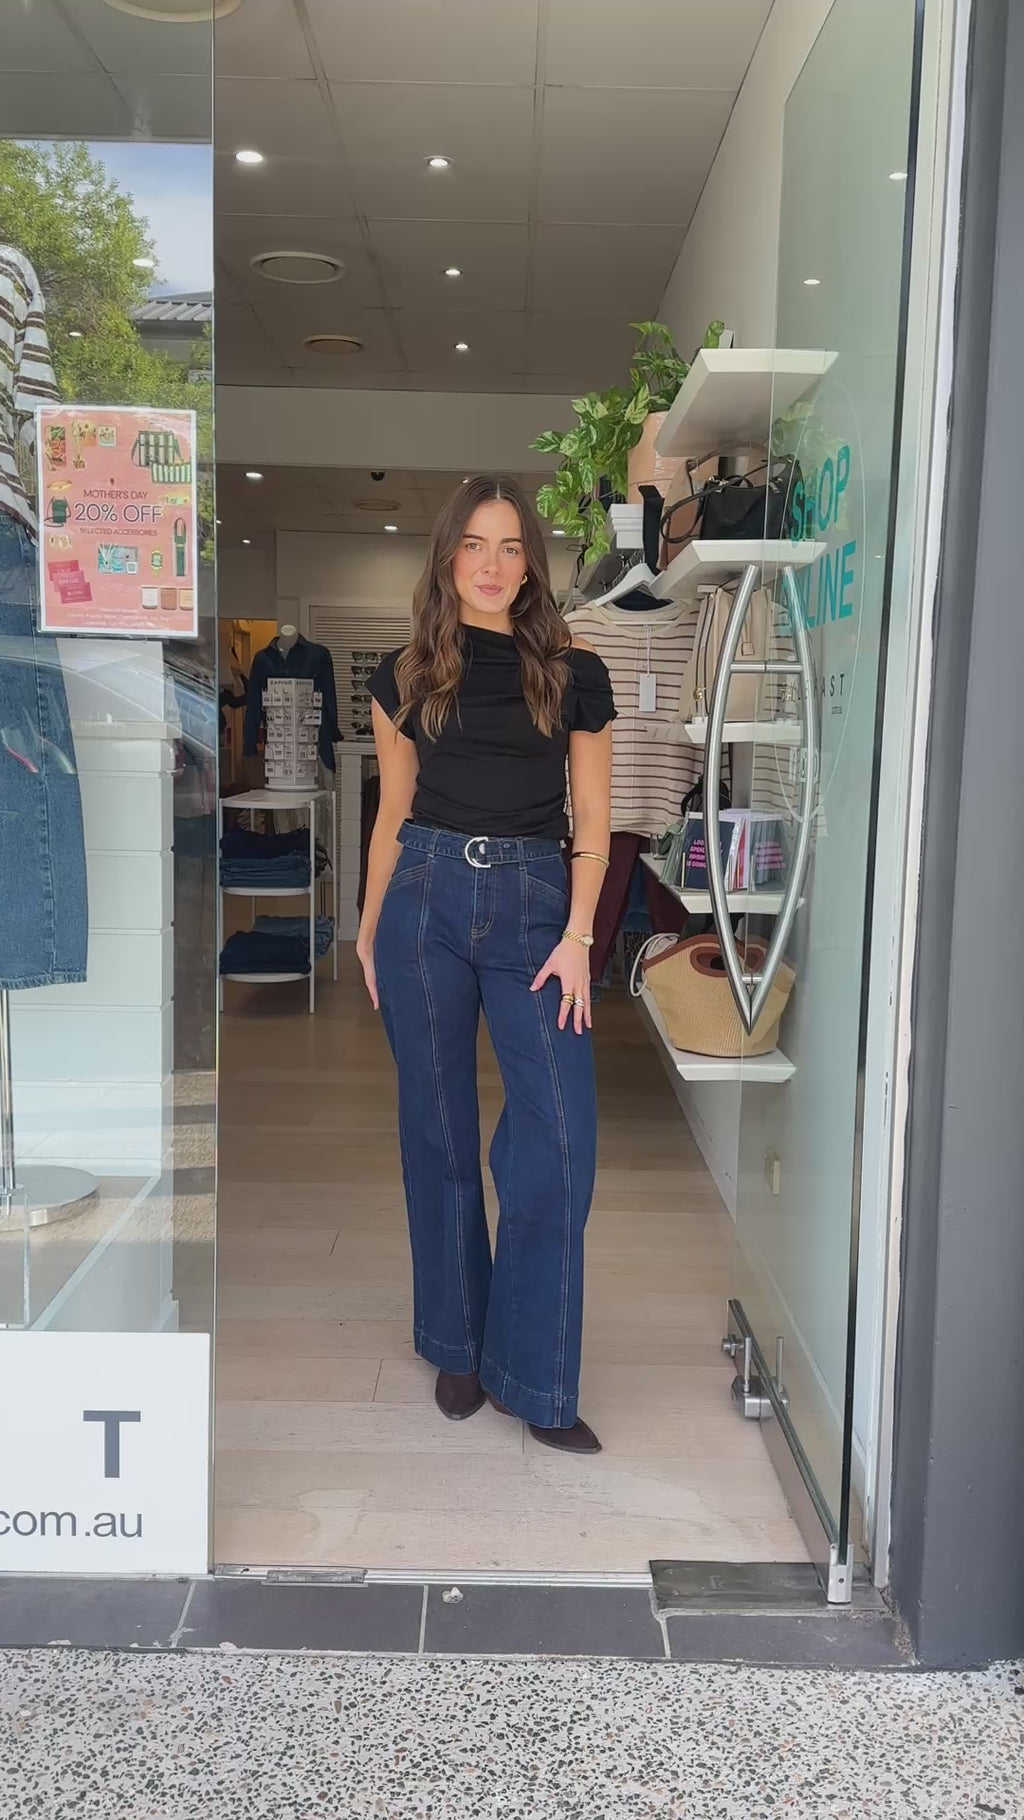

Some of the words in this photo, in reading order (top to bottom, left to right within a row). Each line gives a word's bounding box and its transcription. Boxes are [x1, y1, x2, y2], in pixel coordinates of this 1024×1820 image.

[83, 489, 129, 499] MOTHER'S
[130, 490, 148, 500] DAY
[790, 445, 851, 548] SHOP
[75, 503, 118, 522] 20%
[123, 504, 162, 522] OFF
[80, 527, 112, 535] SELECTED
[83, 1410, 141, 1478] T
